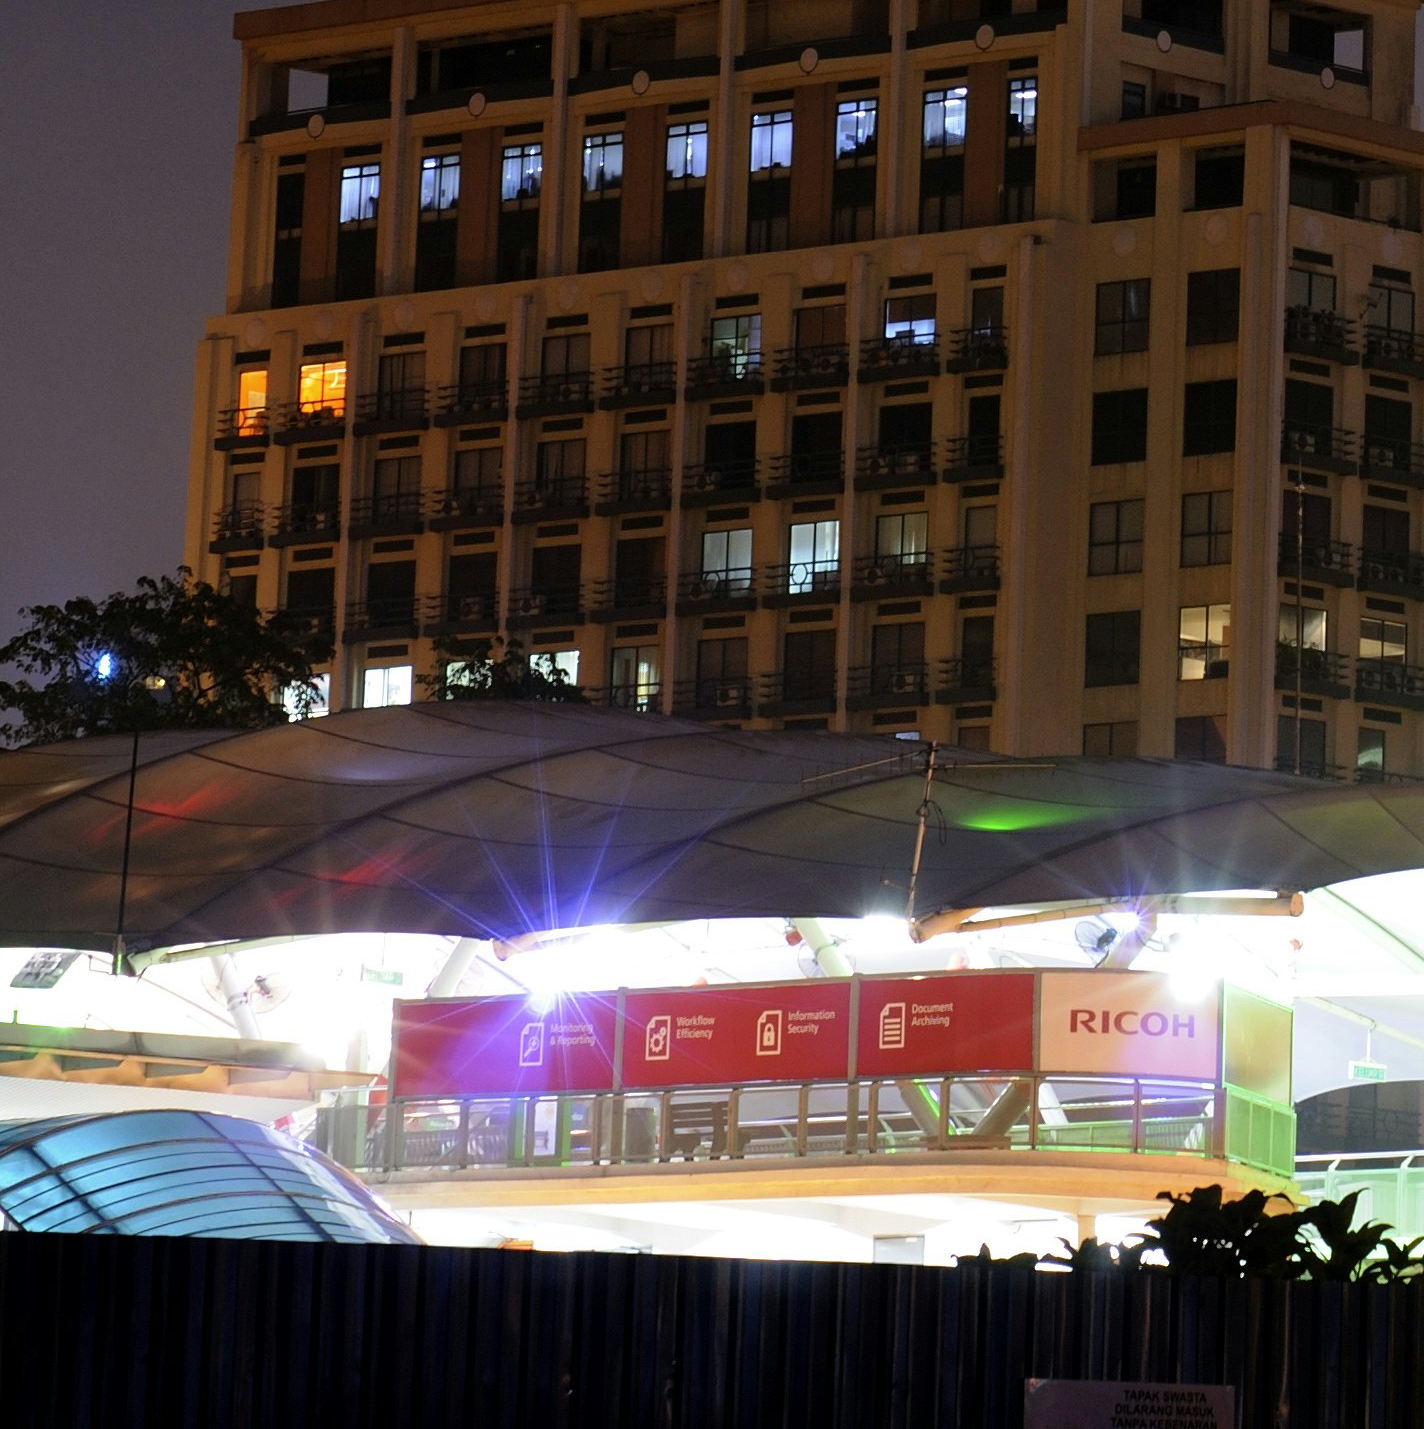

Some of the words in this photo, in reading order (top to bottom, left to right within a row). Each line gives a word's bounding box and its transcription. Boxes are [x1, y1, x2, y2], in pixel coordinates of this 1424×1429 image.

[911, 1002, 953, 1014] Document
[676, 1015, 715, 1027] Workflow
[787, 1009, 836, 1021] Information
[911, 1014, 950, 1027] Archiving
[550, 1023, 593, 1035] Monitoring
[787, 1023, 819, 1036] Security
[1069, 1009, 1195, 1038] RICOH
[676, 1028, 713, 1040] Efficiency
[557, 1035, 595, 1047] Reporting
[1124, 1390, 1160, 1401] TAPAK
[1163, 1392, 1207, 1403] SWASTA
[1115, 1404, 1173, 1415] DILARANG
[1175, 1406, 1214, 1417] MASUK
[1111, 1418, 1148, 1429] TANPA
